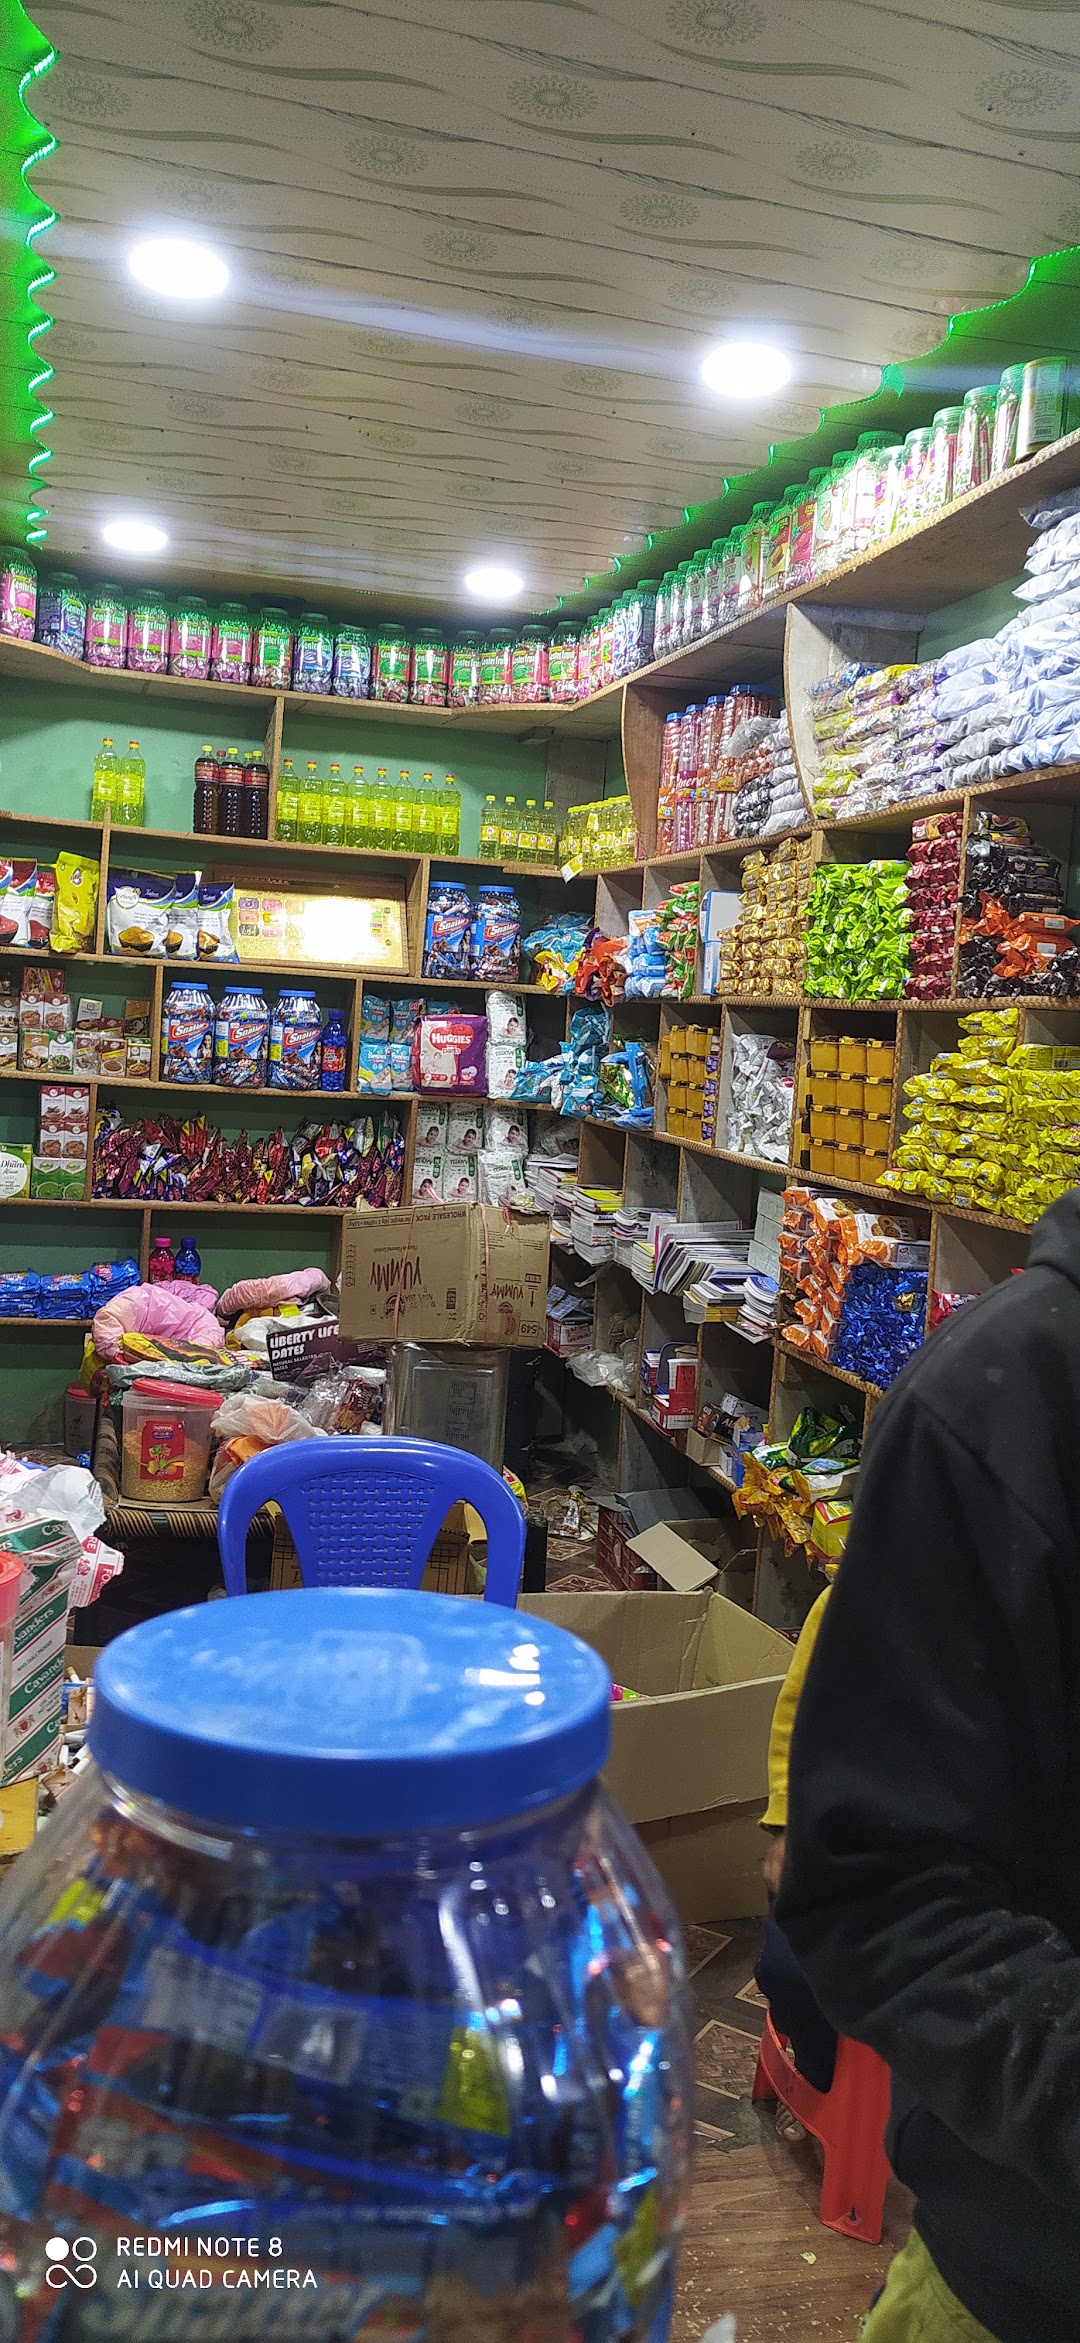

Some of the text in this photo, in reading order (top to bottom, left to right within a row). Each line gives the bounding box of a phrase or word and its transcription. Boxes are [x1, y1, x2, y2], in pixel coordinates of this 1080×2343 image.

[432, 1033, 472, 1044] HUGGIES
[415, 1210, 467, 1222] WHOLESALE PACK
[370, 1257, 422, 1292] YUMMY
[490, 1283, 524, 1299] YUMMY
[521, 1325, 538, 1334] 549
[271, 1343, 305, 1360] DATES
